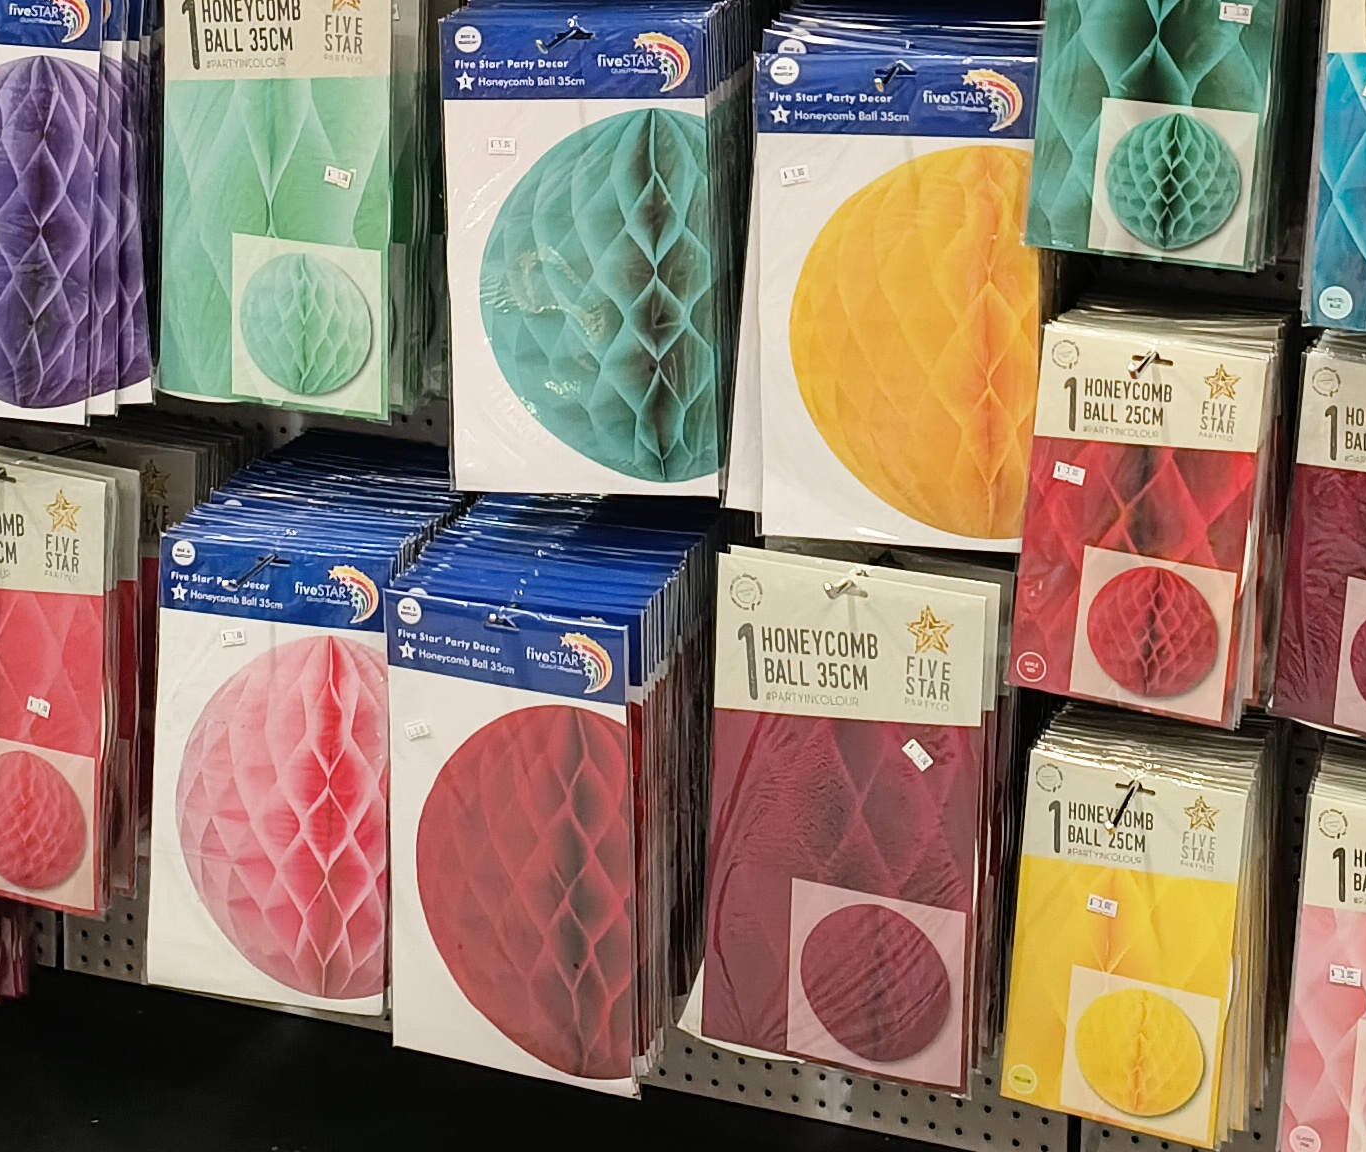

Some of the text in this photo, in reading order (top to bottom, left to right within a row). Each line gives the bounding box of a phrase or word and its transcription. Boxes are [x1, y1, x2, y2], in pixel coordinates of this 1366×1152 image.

[324, 13, 364, 36] FIVE
[205, 25, 294, 53] BALL 35CM
[324, 35, 364, 55] STAR
[454, 57, 475, 70] Five
[507, 57, 536, 73] Party
[538, 57, 569, 70] Decor
[477, 75, 585, 89] Honeycomb Ball 35cm
[1063, 377, 1173, 431] 1 HONEYCOMB
[1084, 401, 1164, 428] BALL 25CM
[737, 622, 879, 701] 1 HONEYCOMB
[764, 658, 869, 691] BALL 35CM
[906, 656, 952, 682] FIVE
[905, 676, 950, 702] STAR
